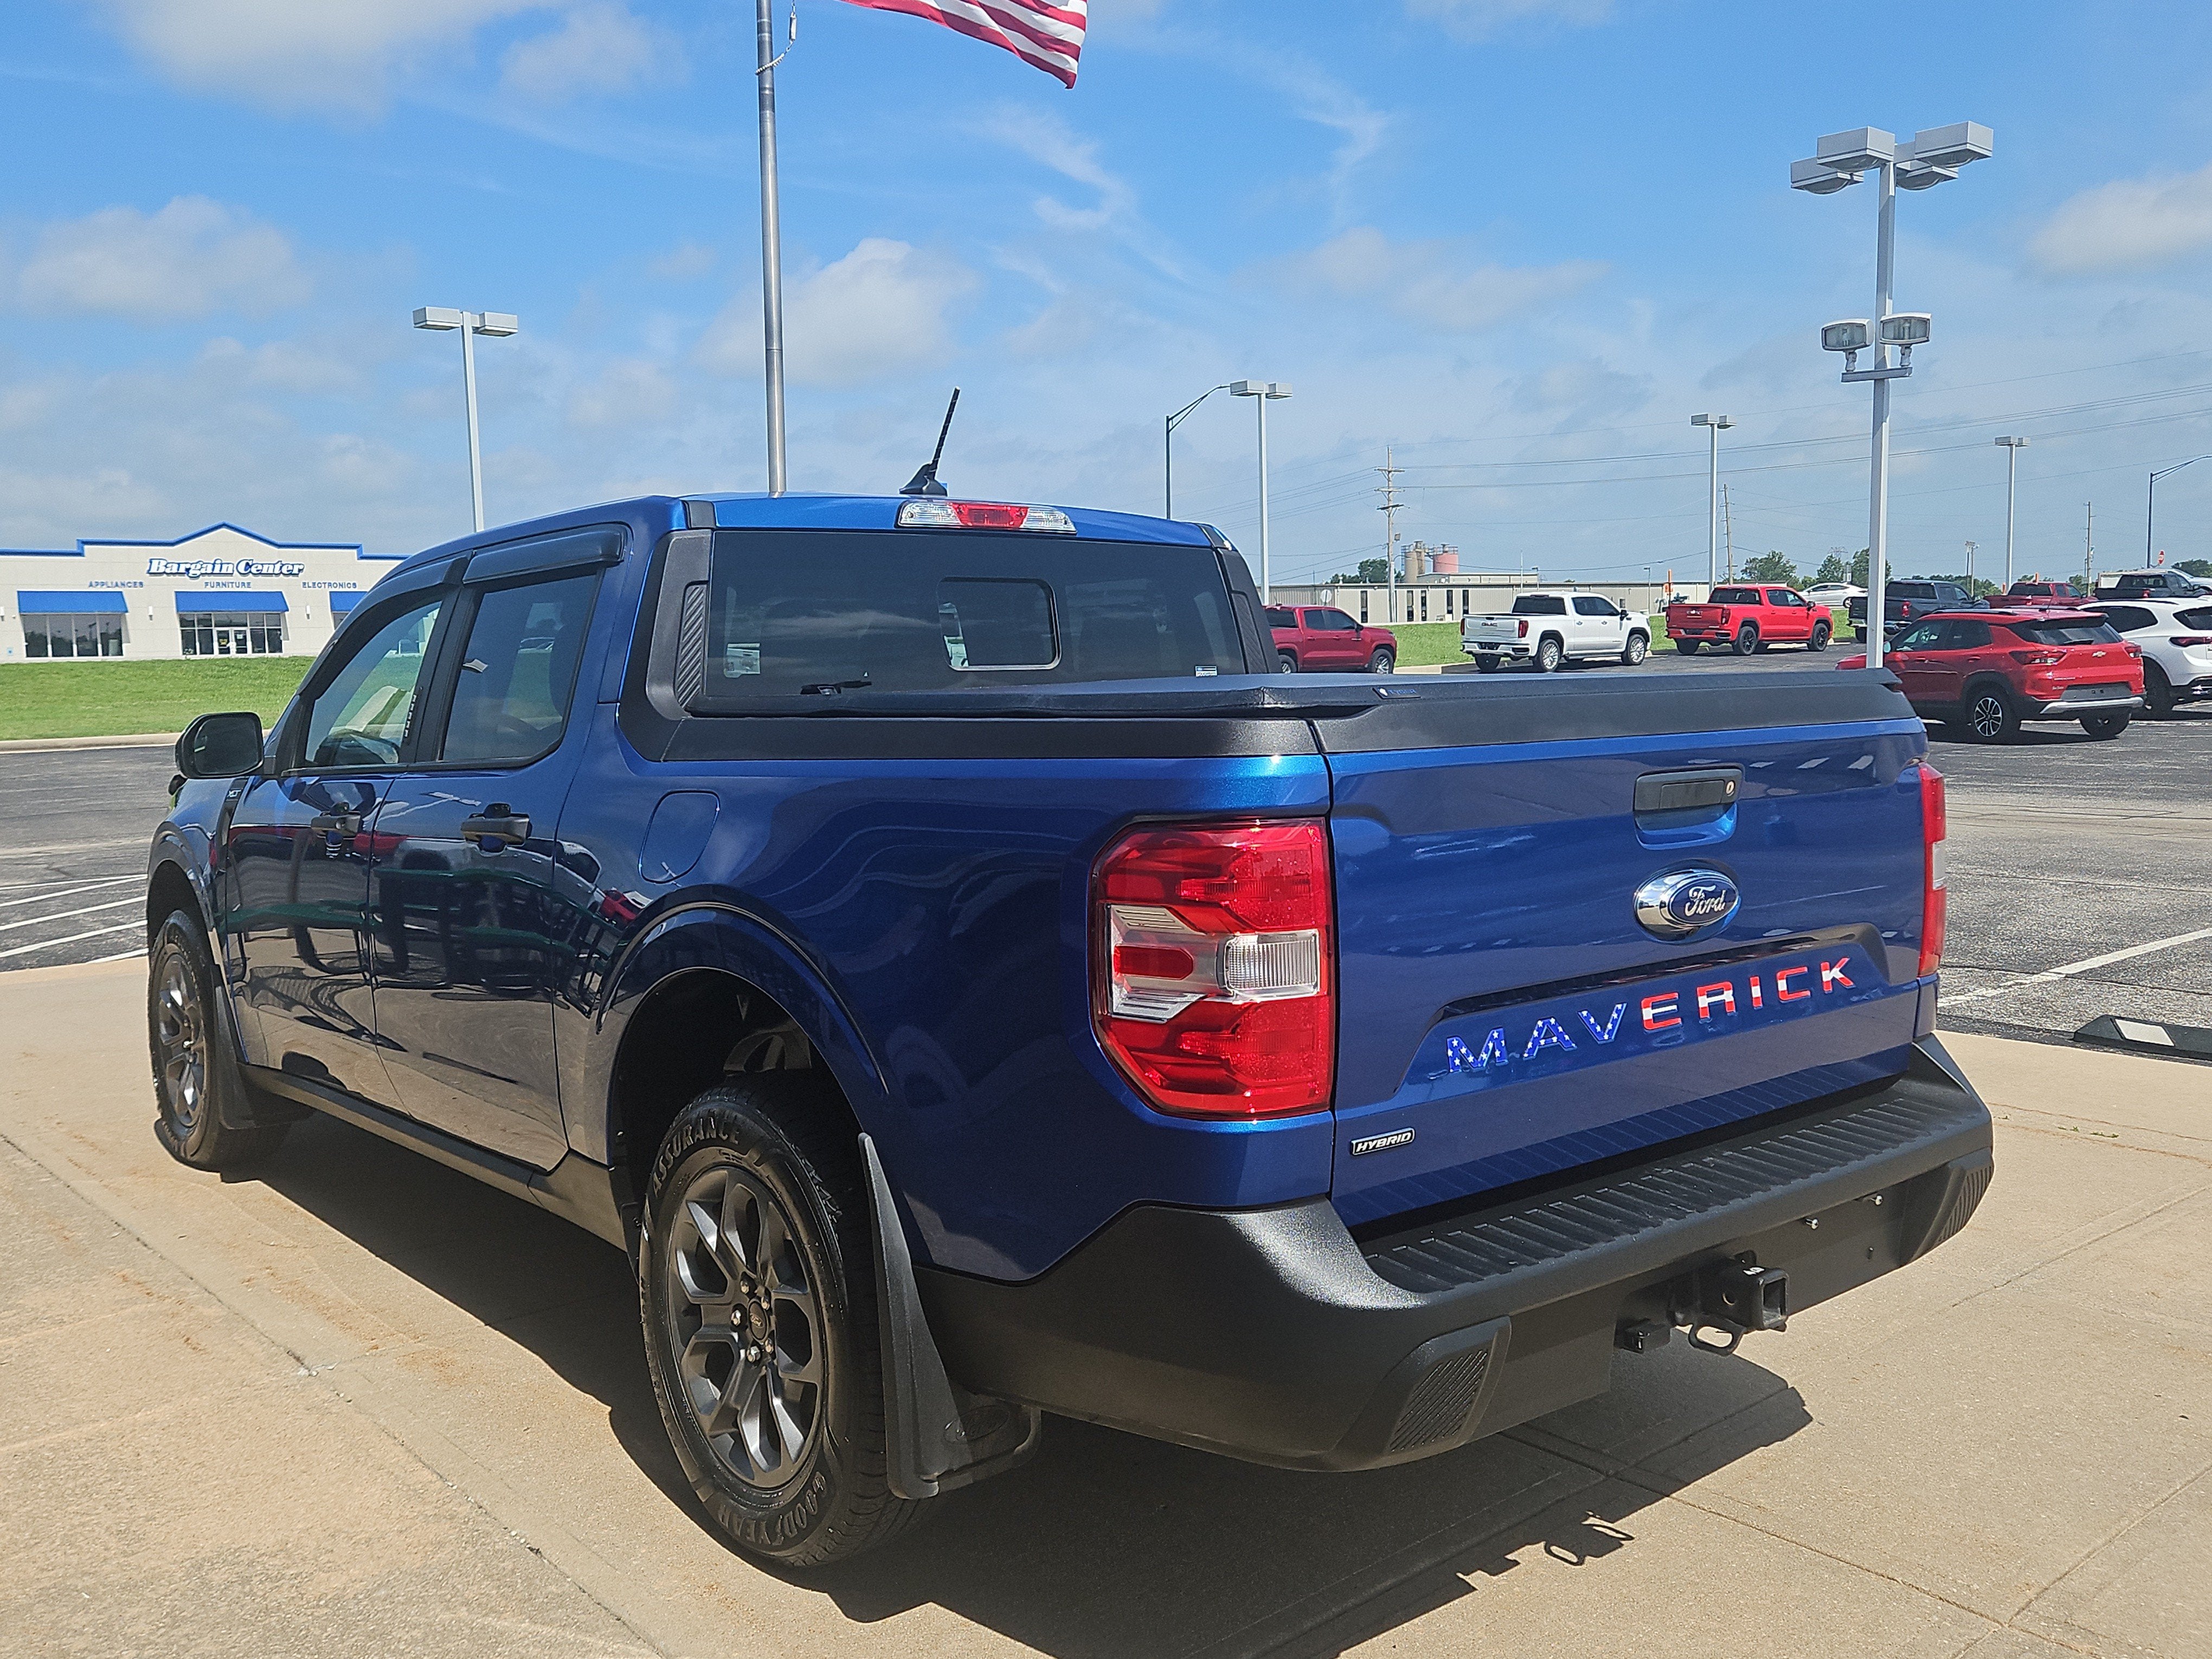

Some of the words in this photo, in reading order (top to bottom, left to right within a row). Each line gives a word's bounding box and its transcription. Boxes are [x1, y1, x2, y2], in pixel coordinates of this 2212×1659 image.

[146, 558, 234, 578] Bargain
[236, 559, 305, 576] Center
[1684, 884, 1727, 916] Ford
[1446, 957, 1855, 1073] MAVERICK
[653, 1110, 741, 1197] ASSURANCE
[1356, 1132, 1412, 1153] HYBRID
